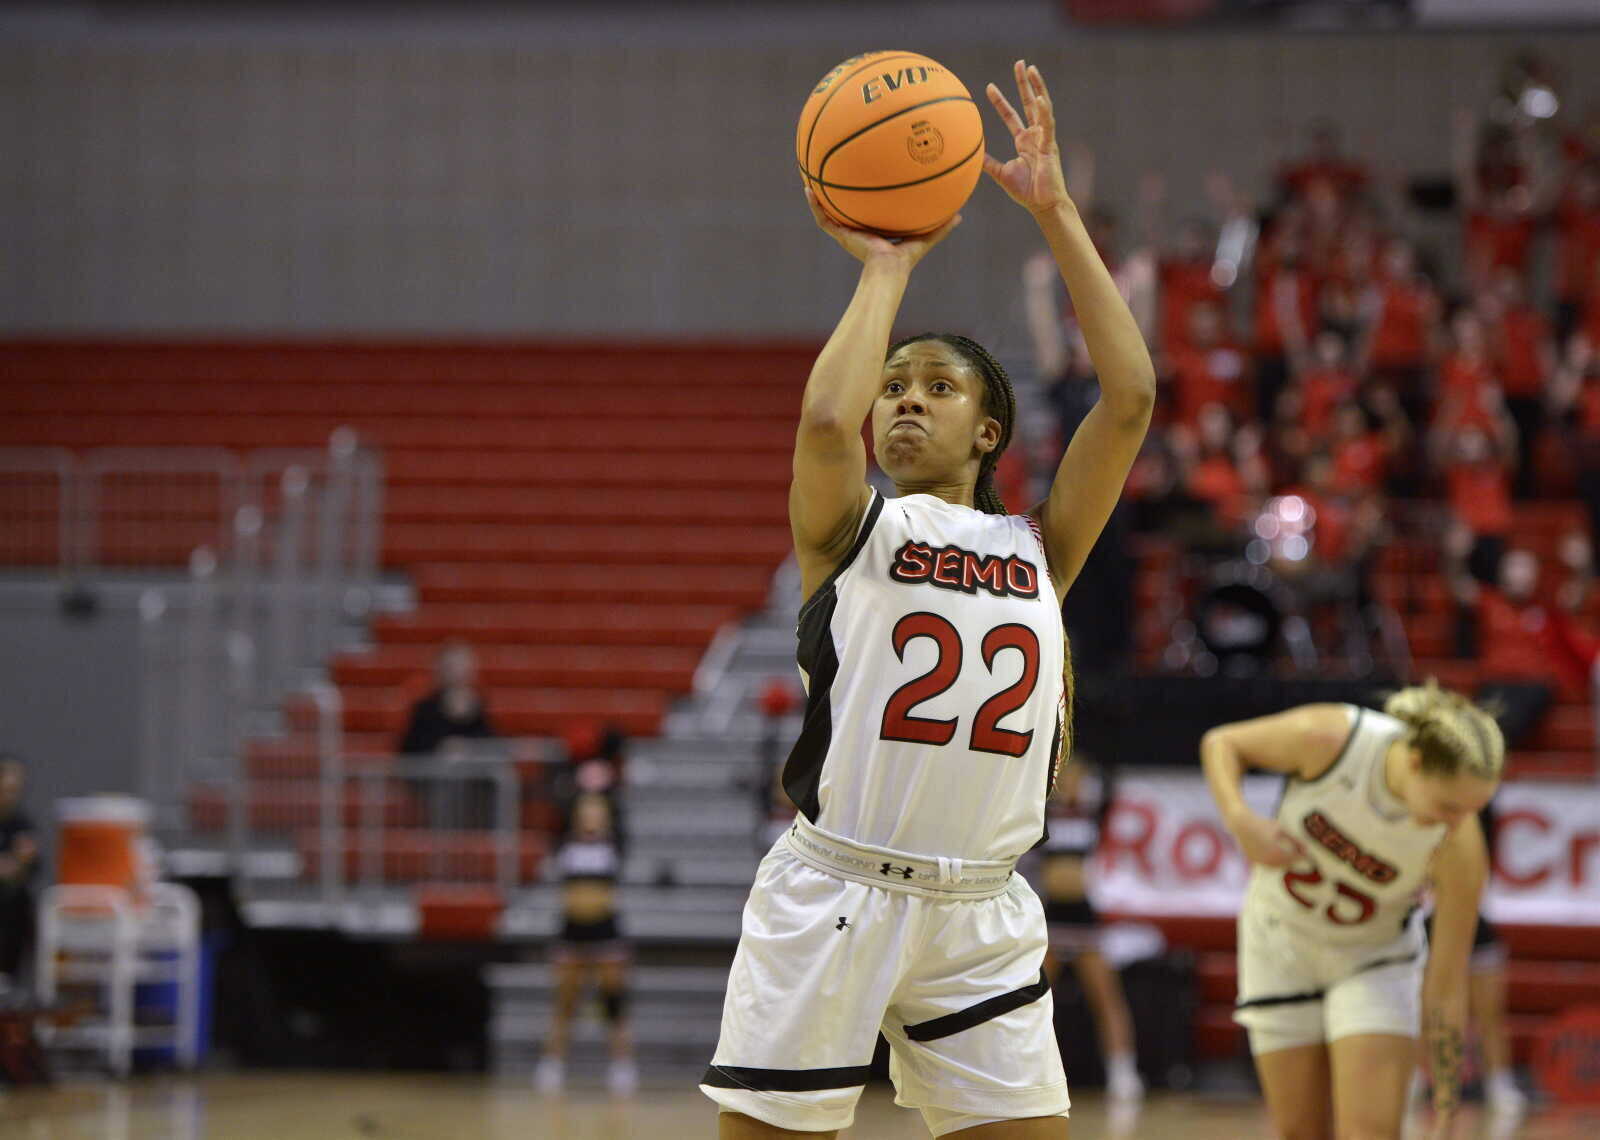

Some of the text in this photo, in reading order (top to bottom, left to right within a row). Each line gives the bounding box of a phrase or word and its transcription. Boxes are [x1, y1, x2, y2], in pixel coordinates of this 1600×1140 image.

[860, 65, 929, 104] EVO
[889, 540, 1040, 600] SEMO
[879, 611, 1041, 758] 22
[1302, 810, 1399, 885] SEMO
